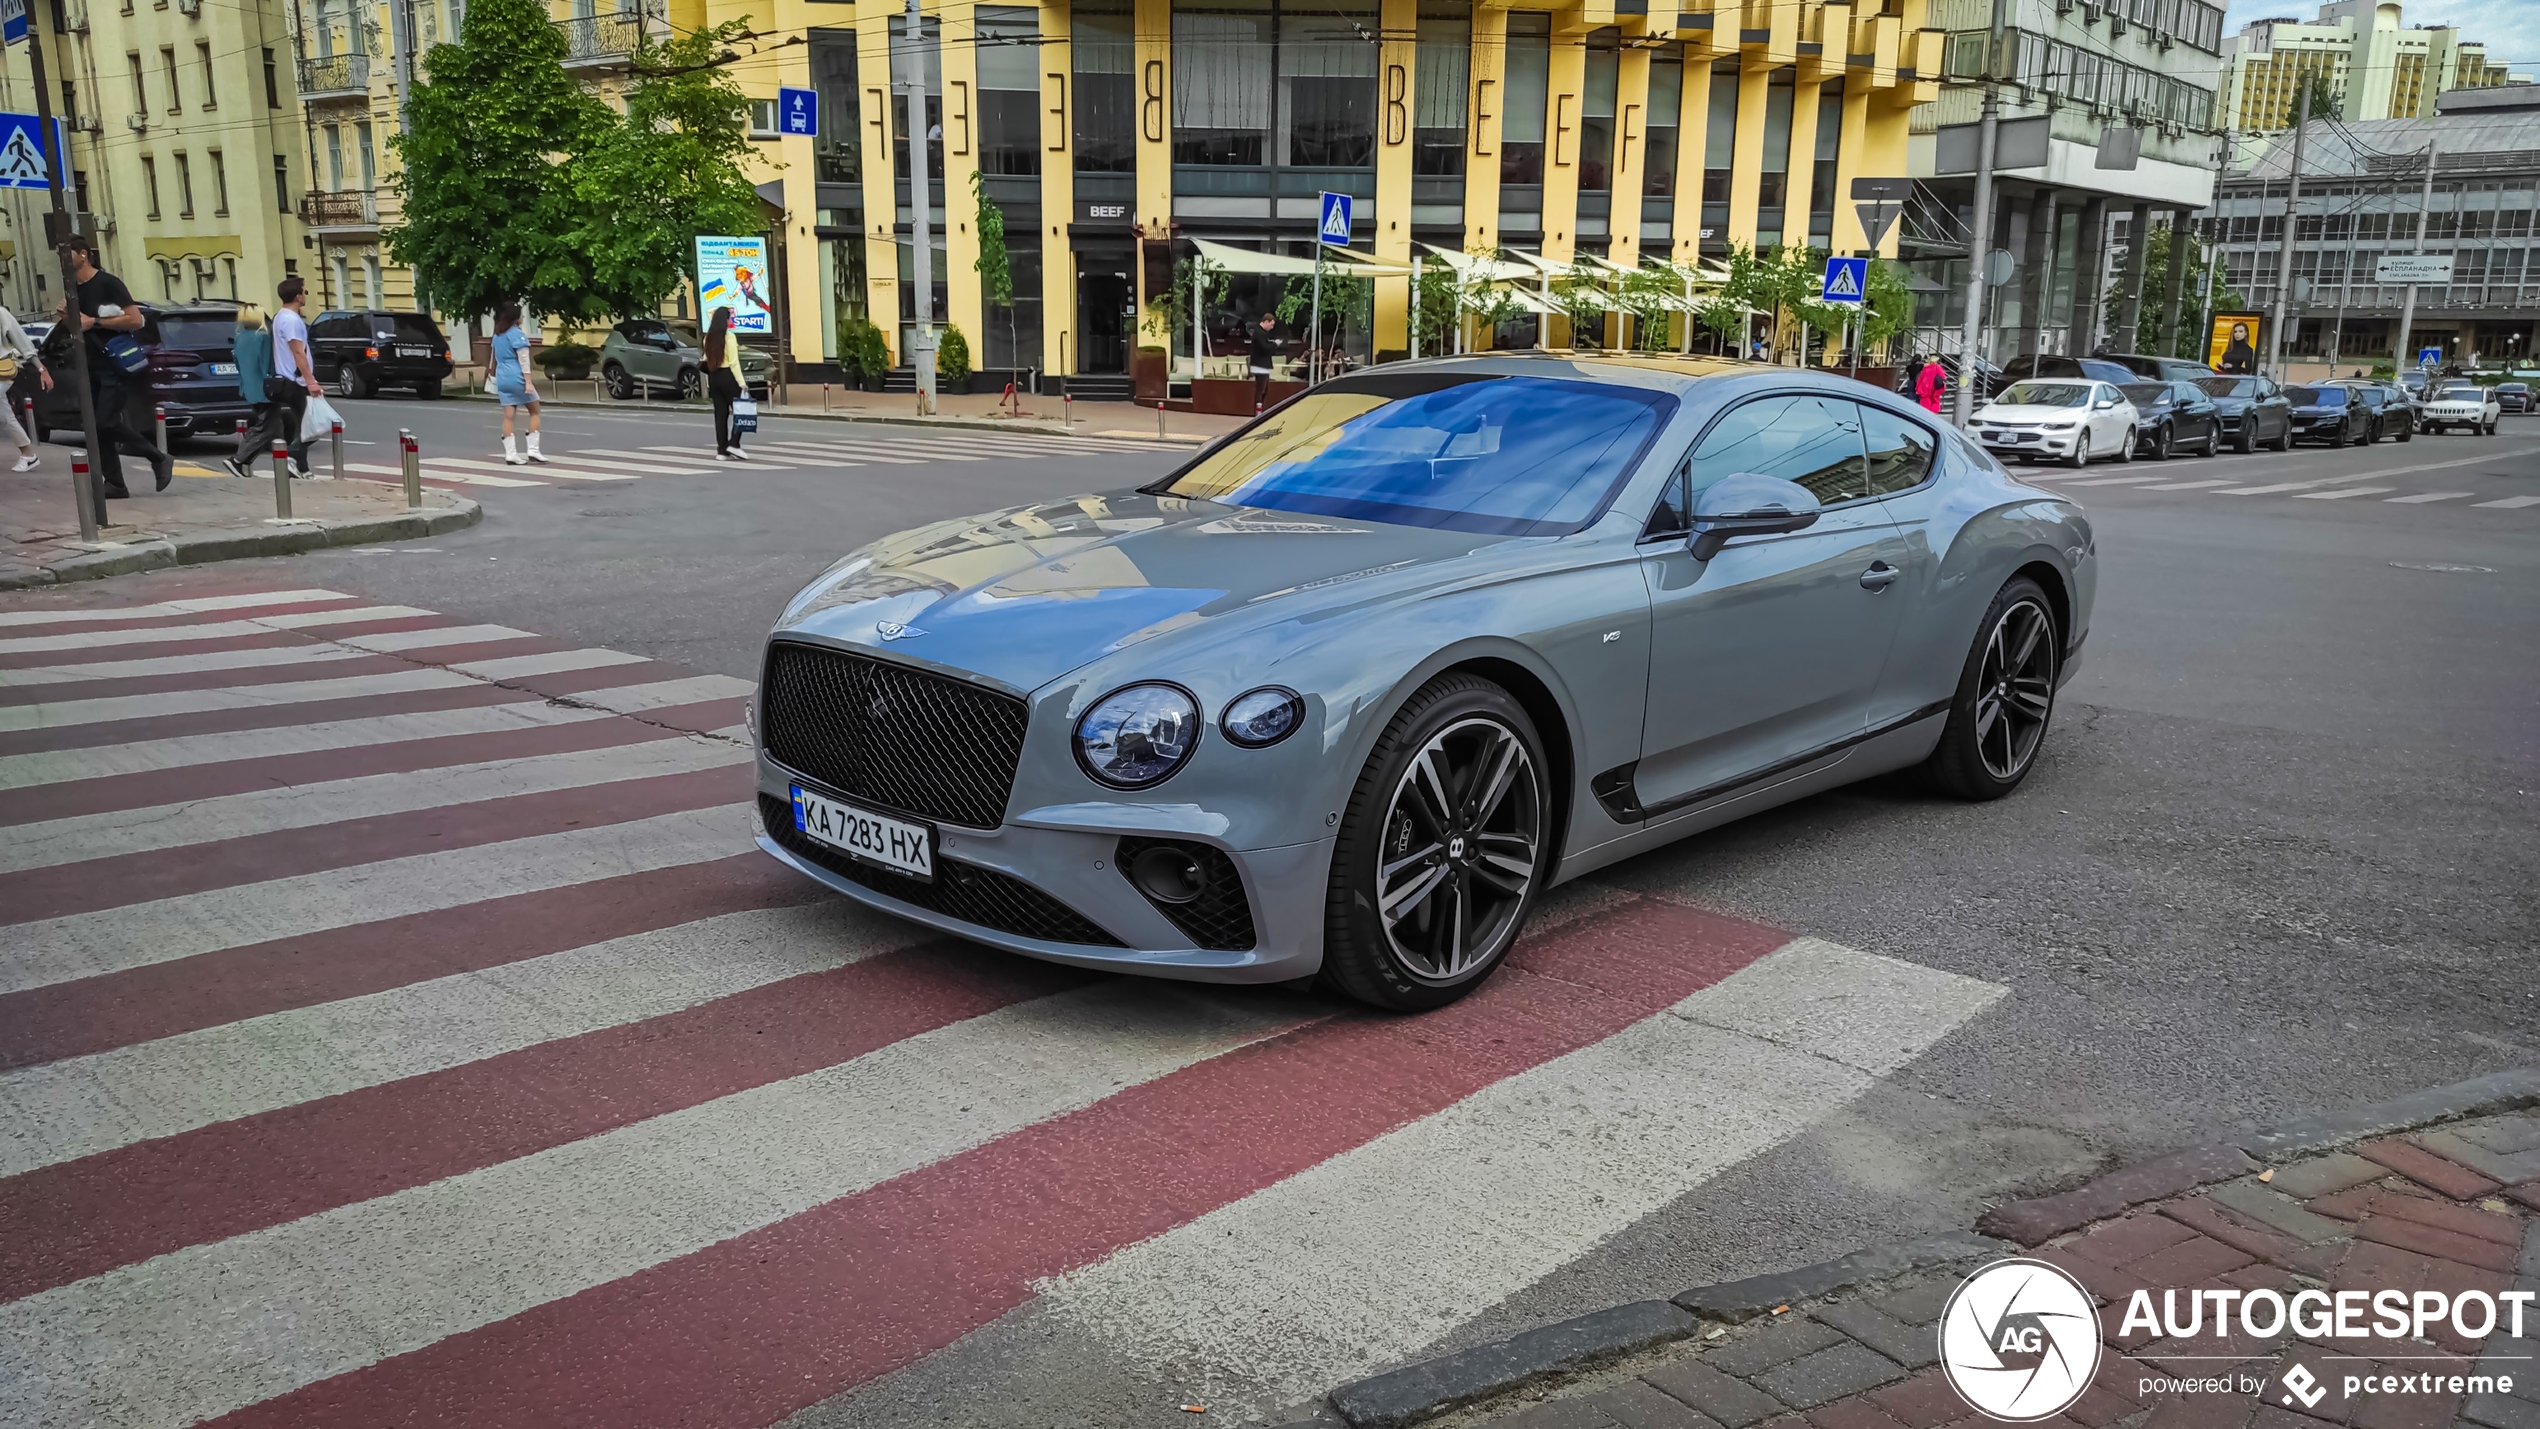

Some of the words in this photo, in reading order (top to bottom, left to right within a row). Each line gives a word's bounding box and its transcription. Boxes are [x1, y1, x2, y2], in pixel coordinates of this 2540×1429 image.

[1386, 64, 1641, 173] BEEF
[1090, 205, 1125, 217] BEEF
[796, 814, 804, 824] UA
[804, 797, 832, 837] KA
[835, 809, 884, 853] 7283
[889, 826, 926, 868] HX
[1449, 837, 1464, 858] B
